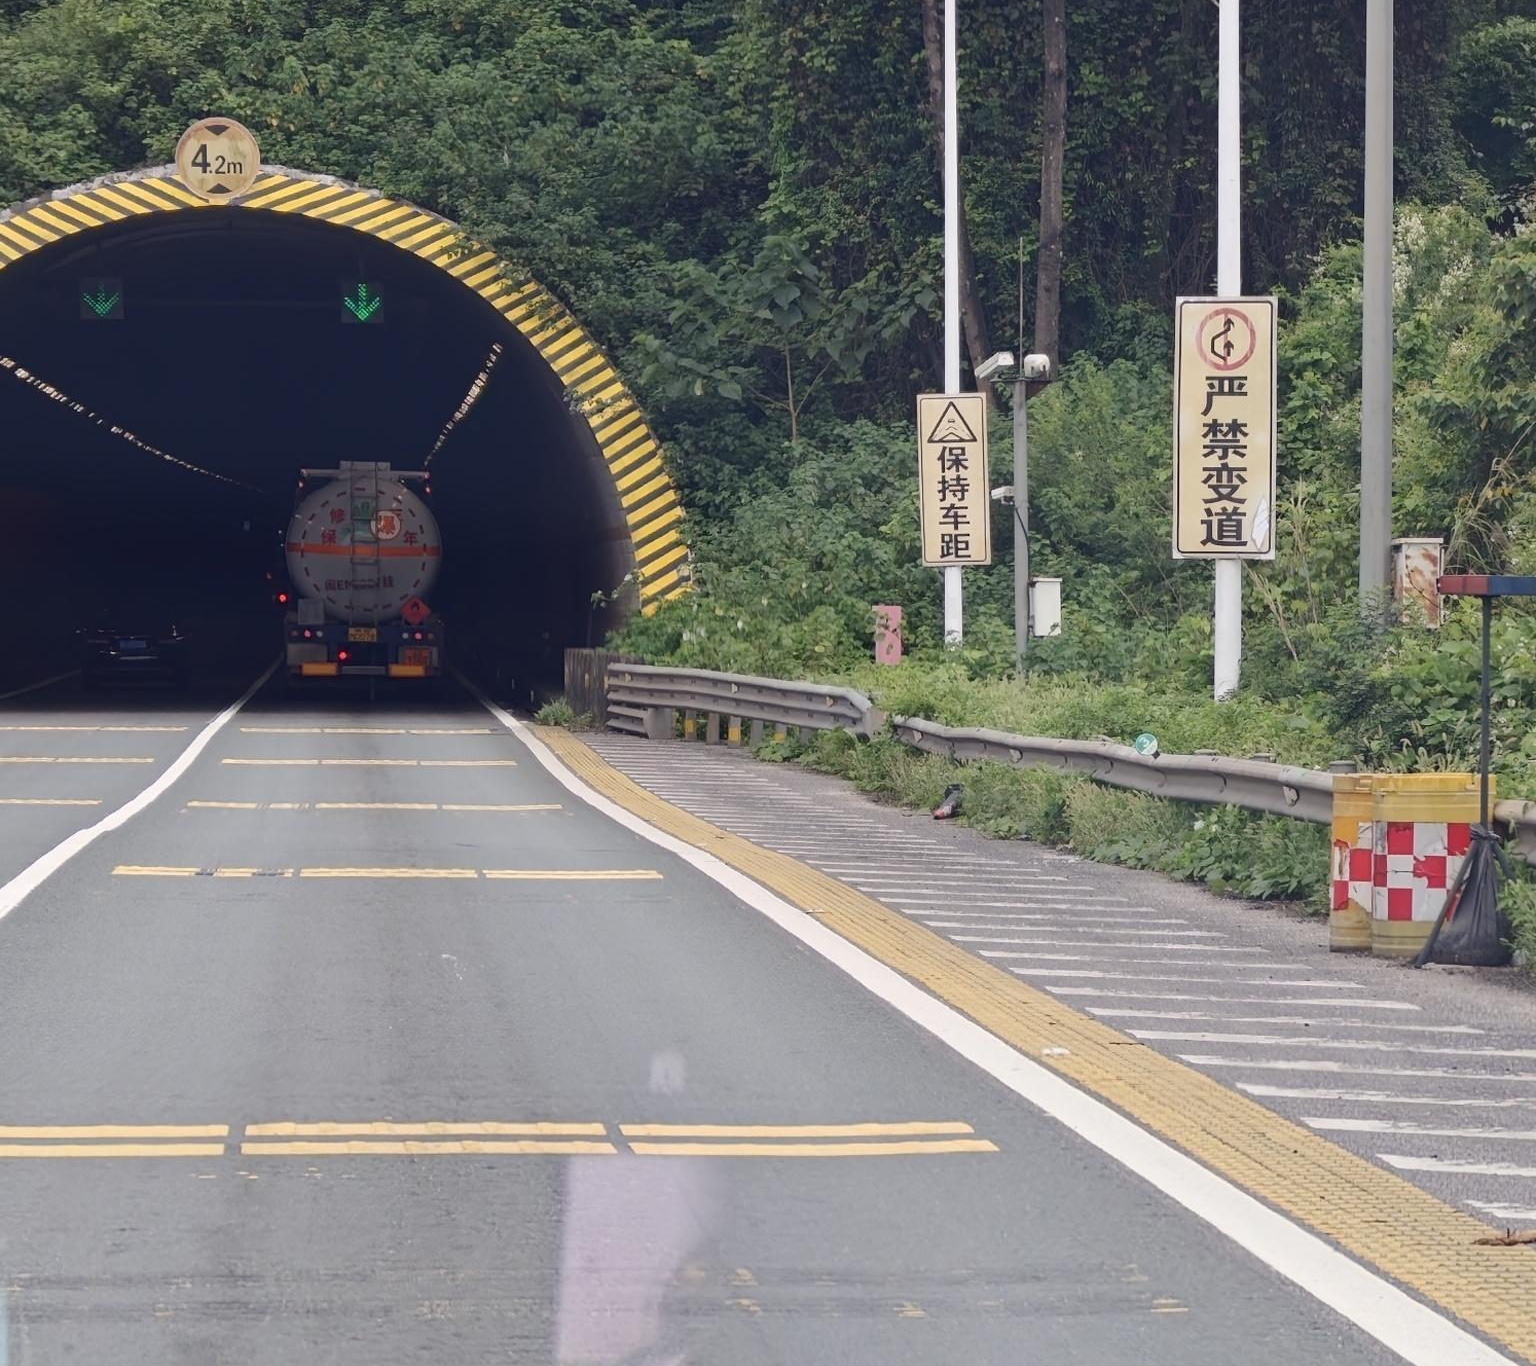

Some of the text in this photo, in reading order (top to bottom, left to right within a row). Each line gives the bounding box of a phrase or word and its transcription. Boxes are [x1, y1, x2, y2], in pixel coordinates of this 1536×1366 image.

[191, 143, 243, 175] 4.2m
[937, 446, 971, 559] 保持车距
[1200, 376, 1249, 547] 严禁变道
